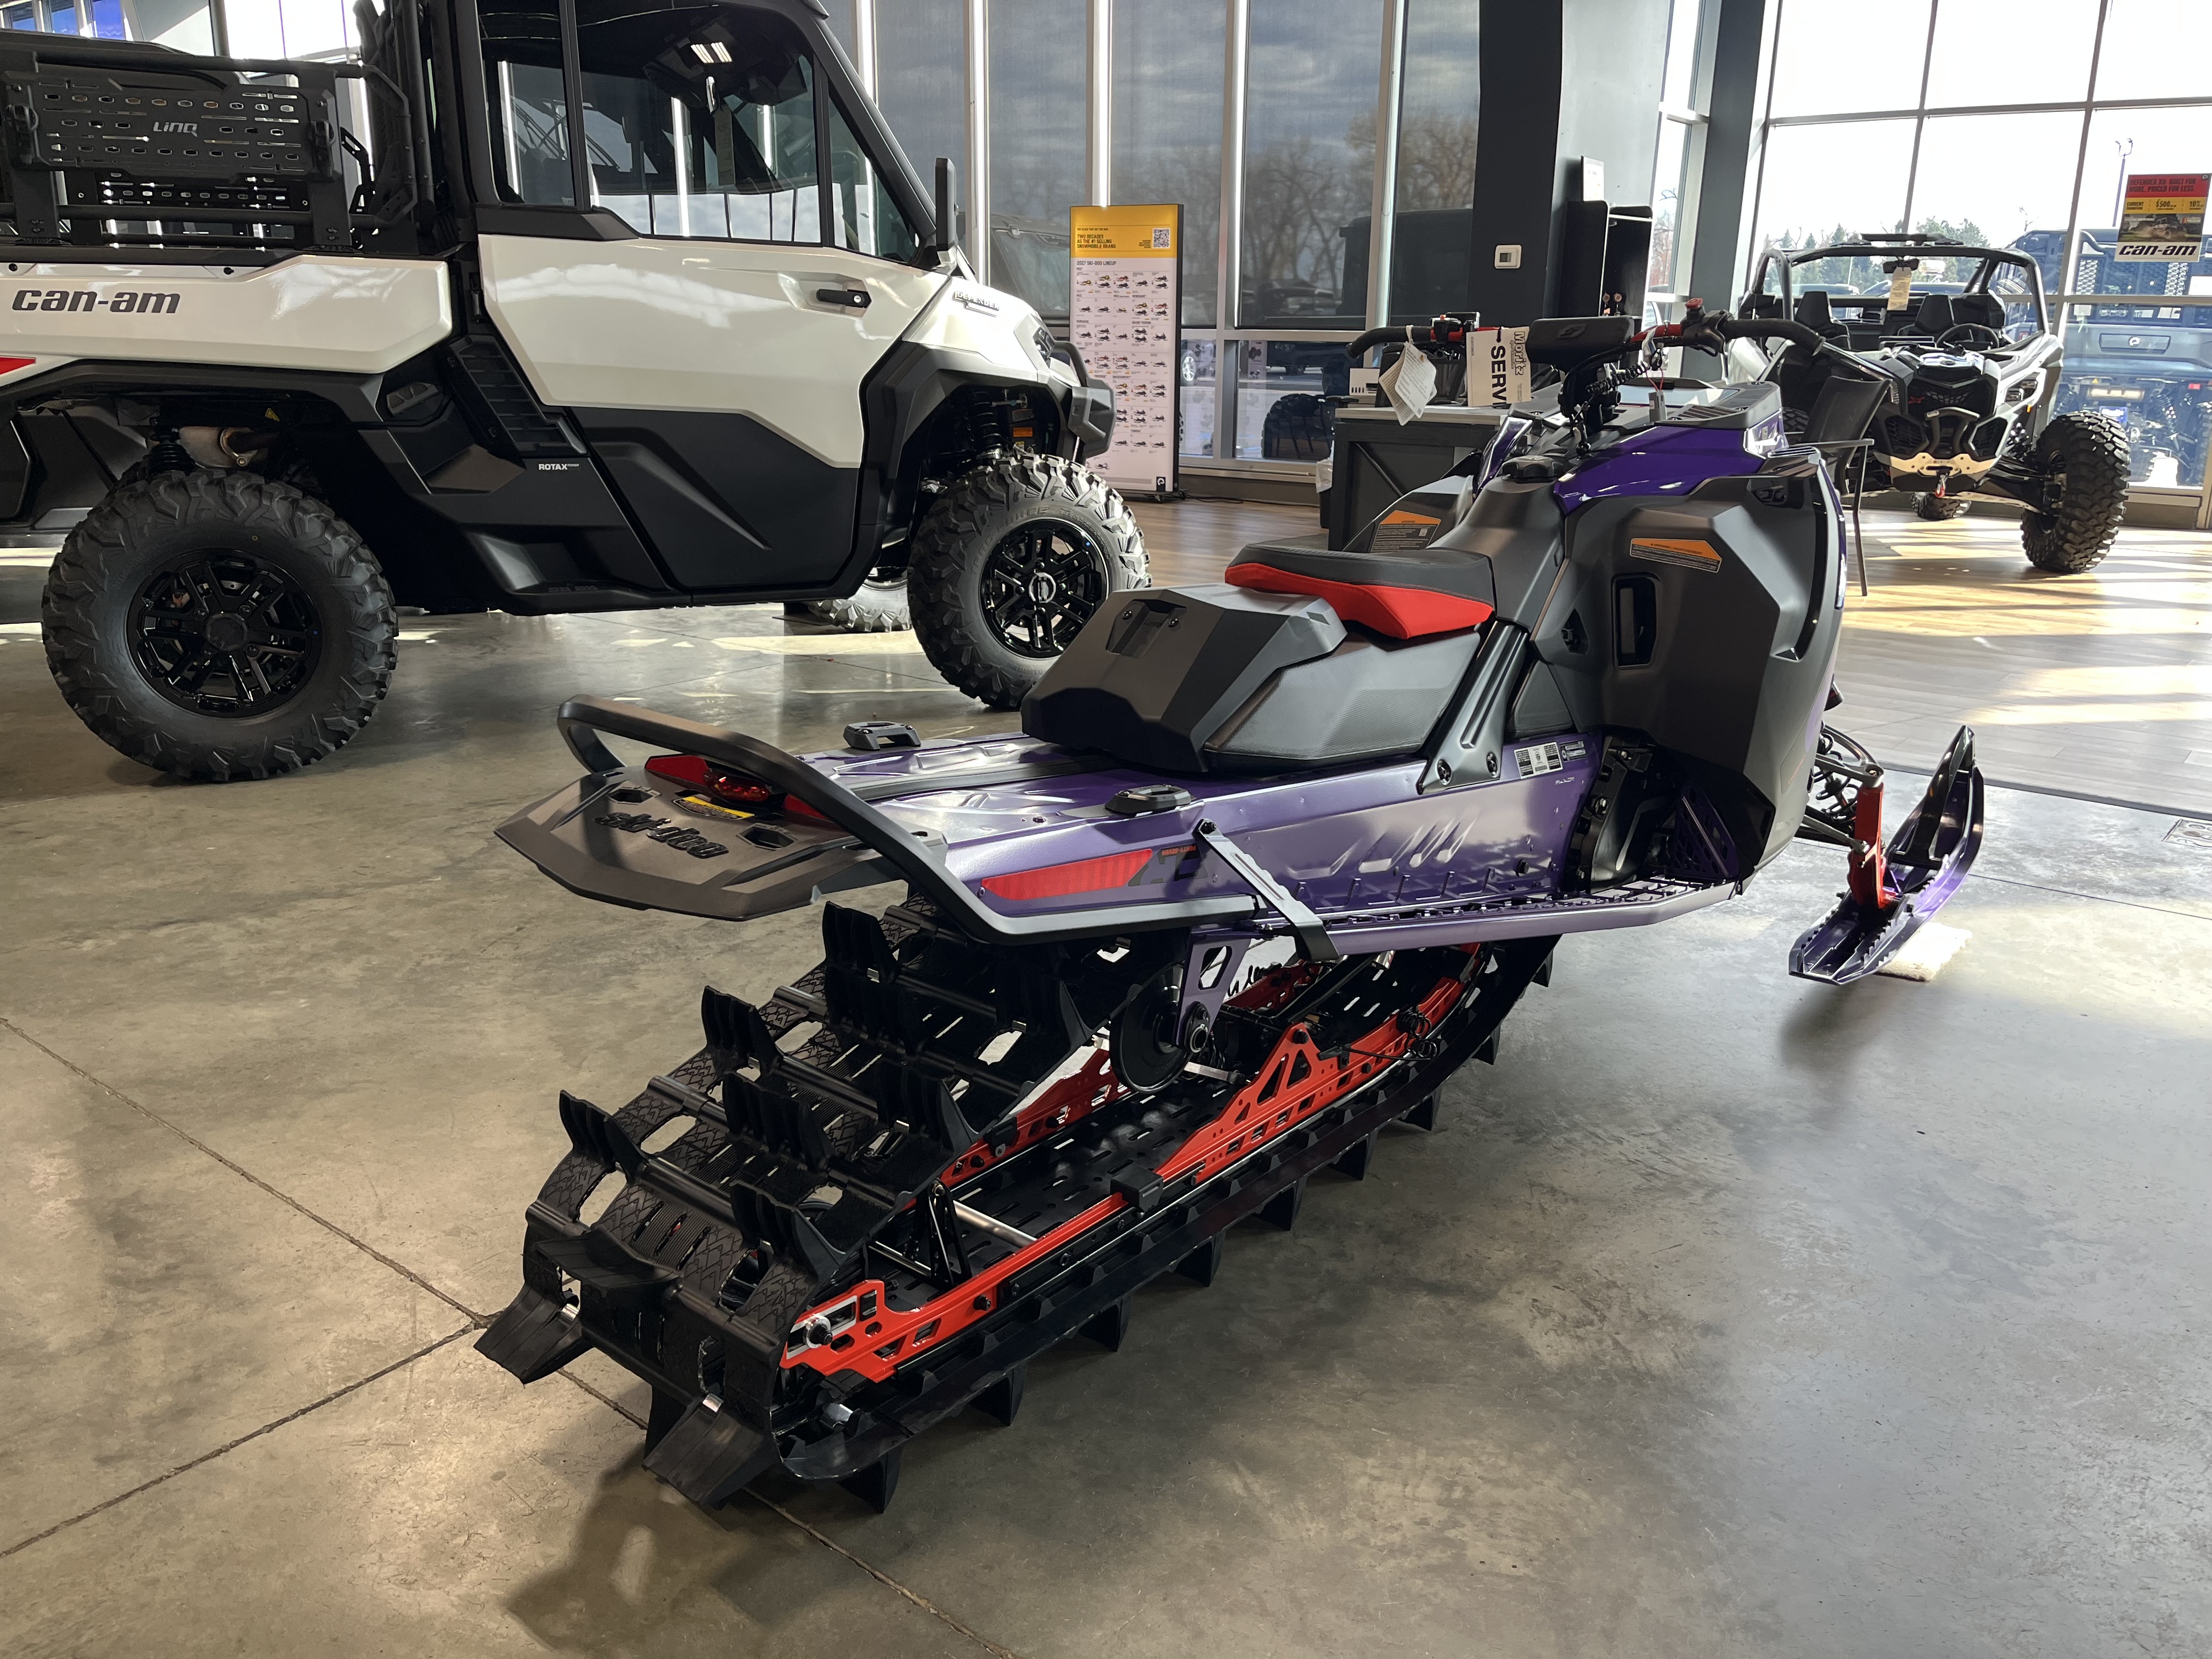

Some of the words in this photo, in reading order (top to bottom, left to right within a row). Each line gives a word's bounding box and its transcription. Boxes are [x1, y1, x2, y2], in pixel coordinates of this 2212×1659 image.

[2119, 245, 2197, 255] can-am
[12, 290, 180, 313] can-am
[1514, 331, 1526, 375] Moritz
